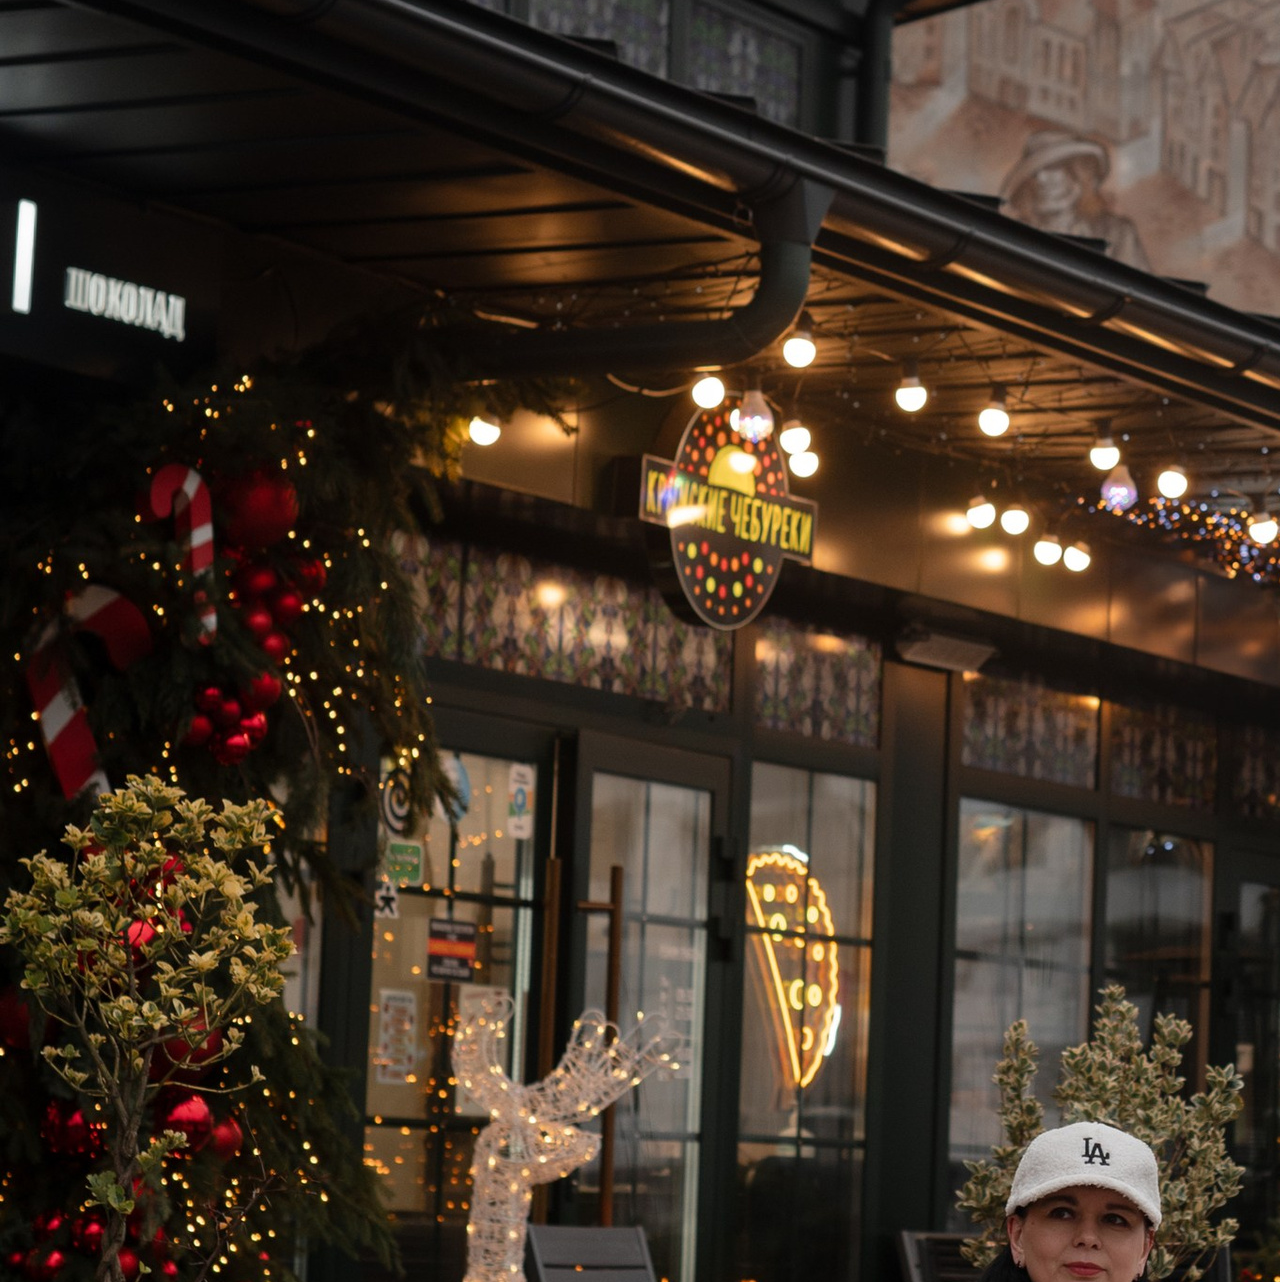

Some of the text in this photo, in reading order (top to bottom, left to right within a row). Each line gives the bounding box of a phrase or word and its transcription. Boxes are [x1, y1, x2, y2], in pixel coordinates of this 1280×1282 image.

[64, 266, 187, 343] ШОКОЛАД
[646, 469, 813, 555] КРМСКИЕ ЧЕБУРЕКИ
[1081, 1137, 1110, 1166] LA
